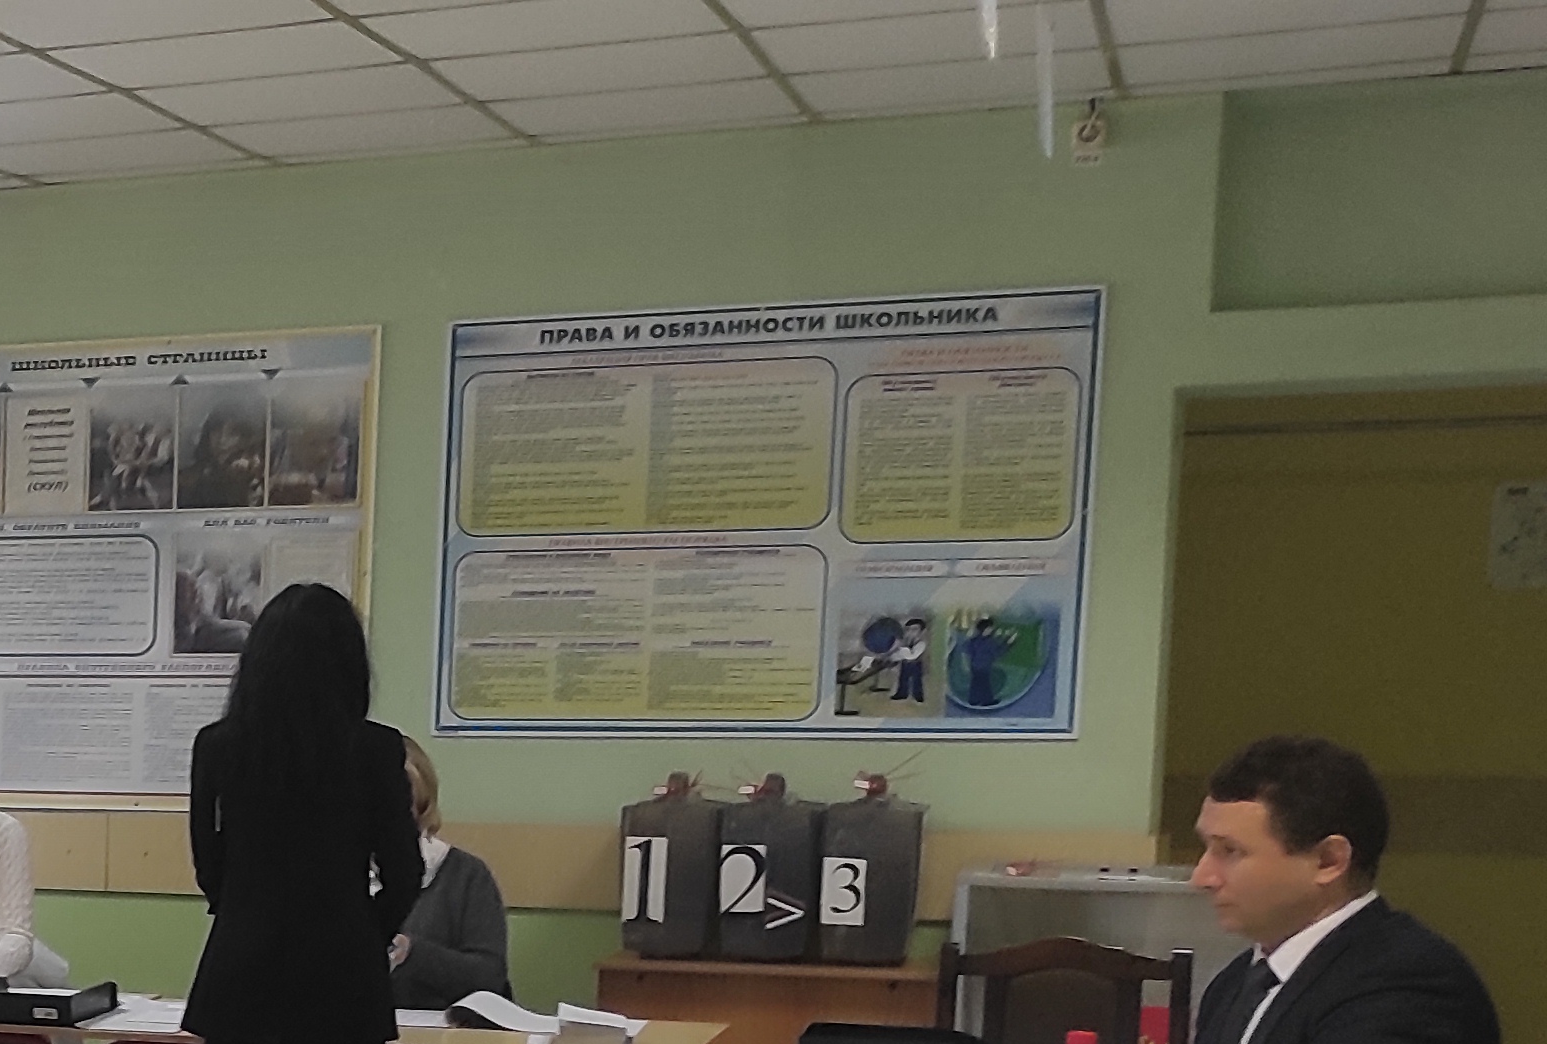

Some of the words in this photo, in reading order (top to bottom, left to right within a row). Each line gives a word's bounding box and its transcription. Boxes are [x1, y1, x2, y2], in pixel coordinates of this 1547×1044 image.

[540, 326, 613, 345] ПРАВА
[624, 325, 640, 340] И
[650, 315, 825, 340] ОБЯЗАННОСТИ
[835, 306, 998, 331] ШКОЛЬНИКА
[623, 838, 663, 923] 1
[720, 845, 766, 914] 2
[829, 863, 861, 913] 3
